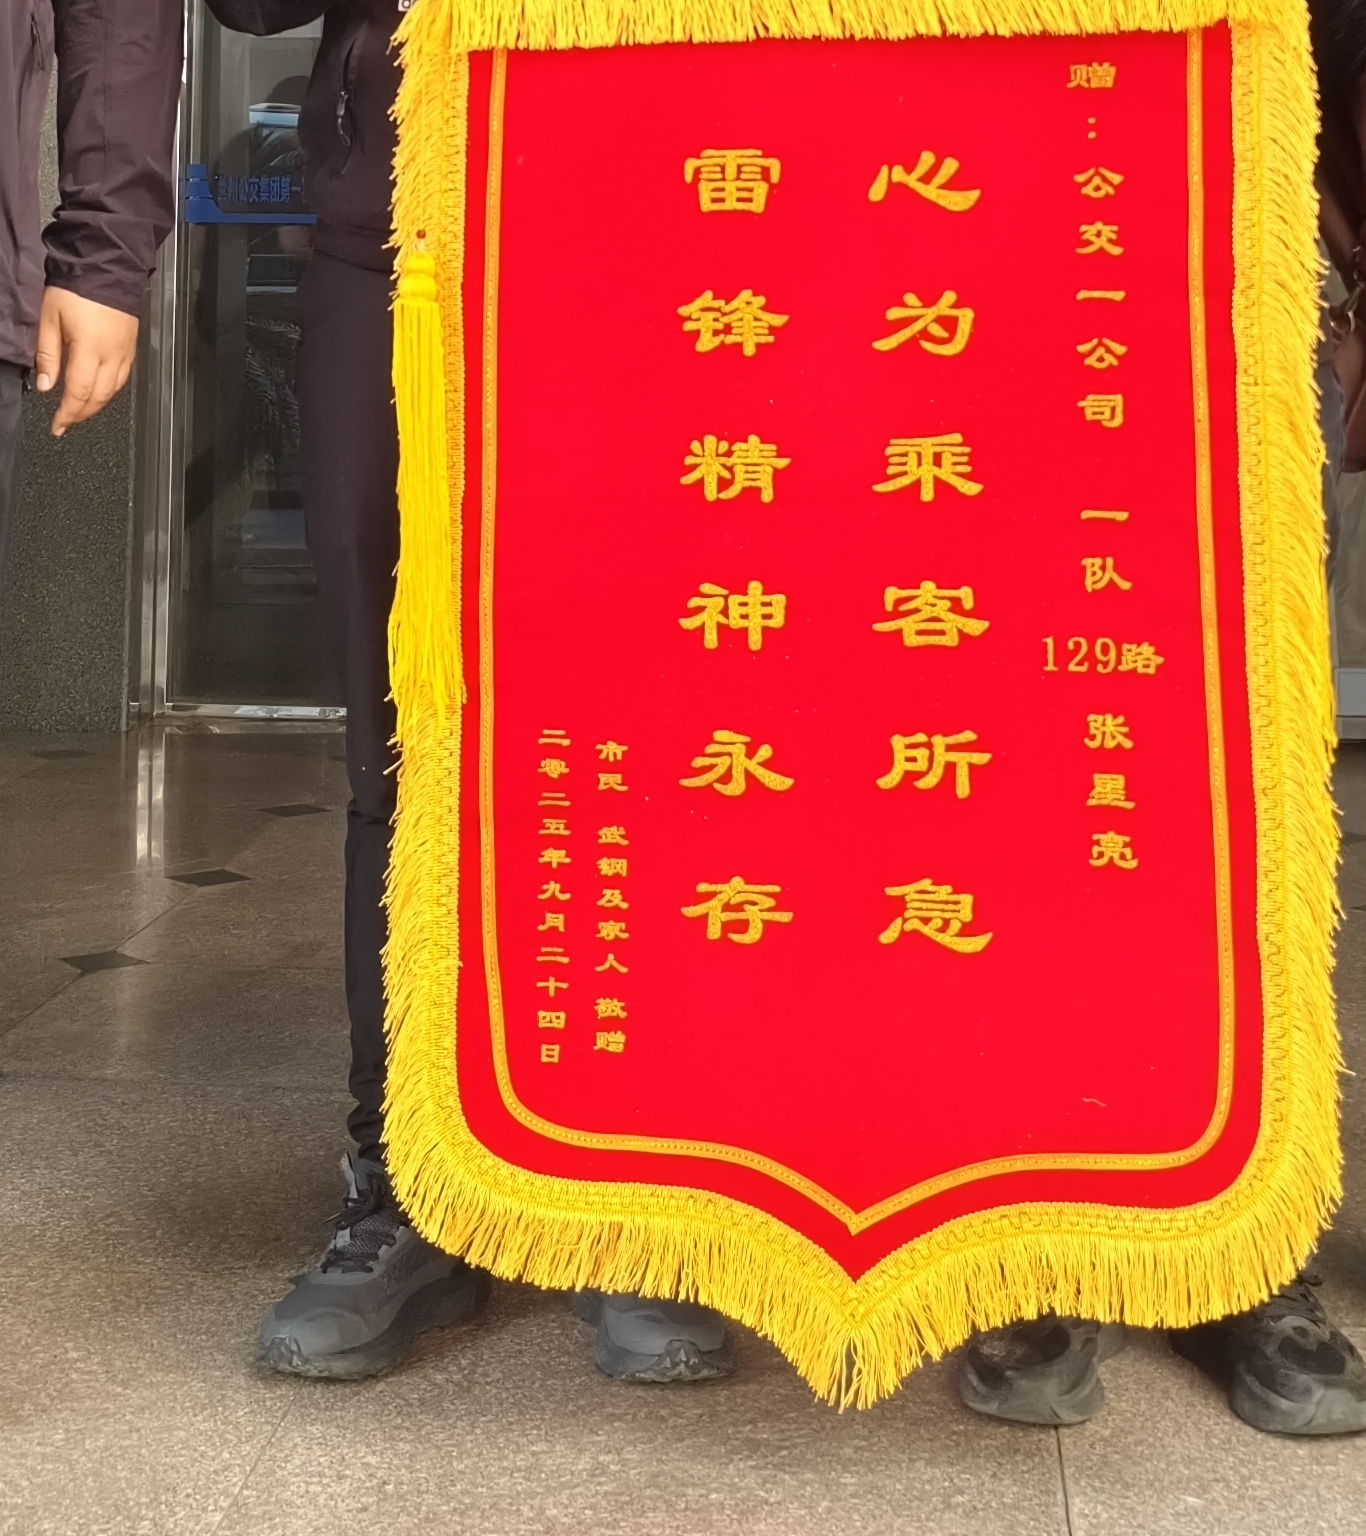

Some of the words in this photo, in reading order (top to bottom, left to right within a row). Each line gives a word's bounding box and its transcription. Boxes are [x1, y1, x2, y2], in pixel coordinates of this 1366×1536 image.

[218, 175, 309, 204] 兰州公交集团第一
[677, 149, 794, 945] 雷锋精神永存
[868, 150, 993, 953] 心为乘客所急
[1080, 509, 1133, 592] 一队
[1042, 636, 1165, 676] 129路
[1084, 712, 1139, 870] 张星亮
[536, 729, 572, 1063] 二零二五年九月二十四日
